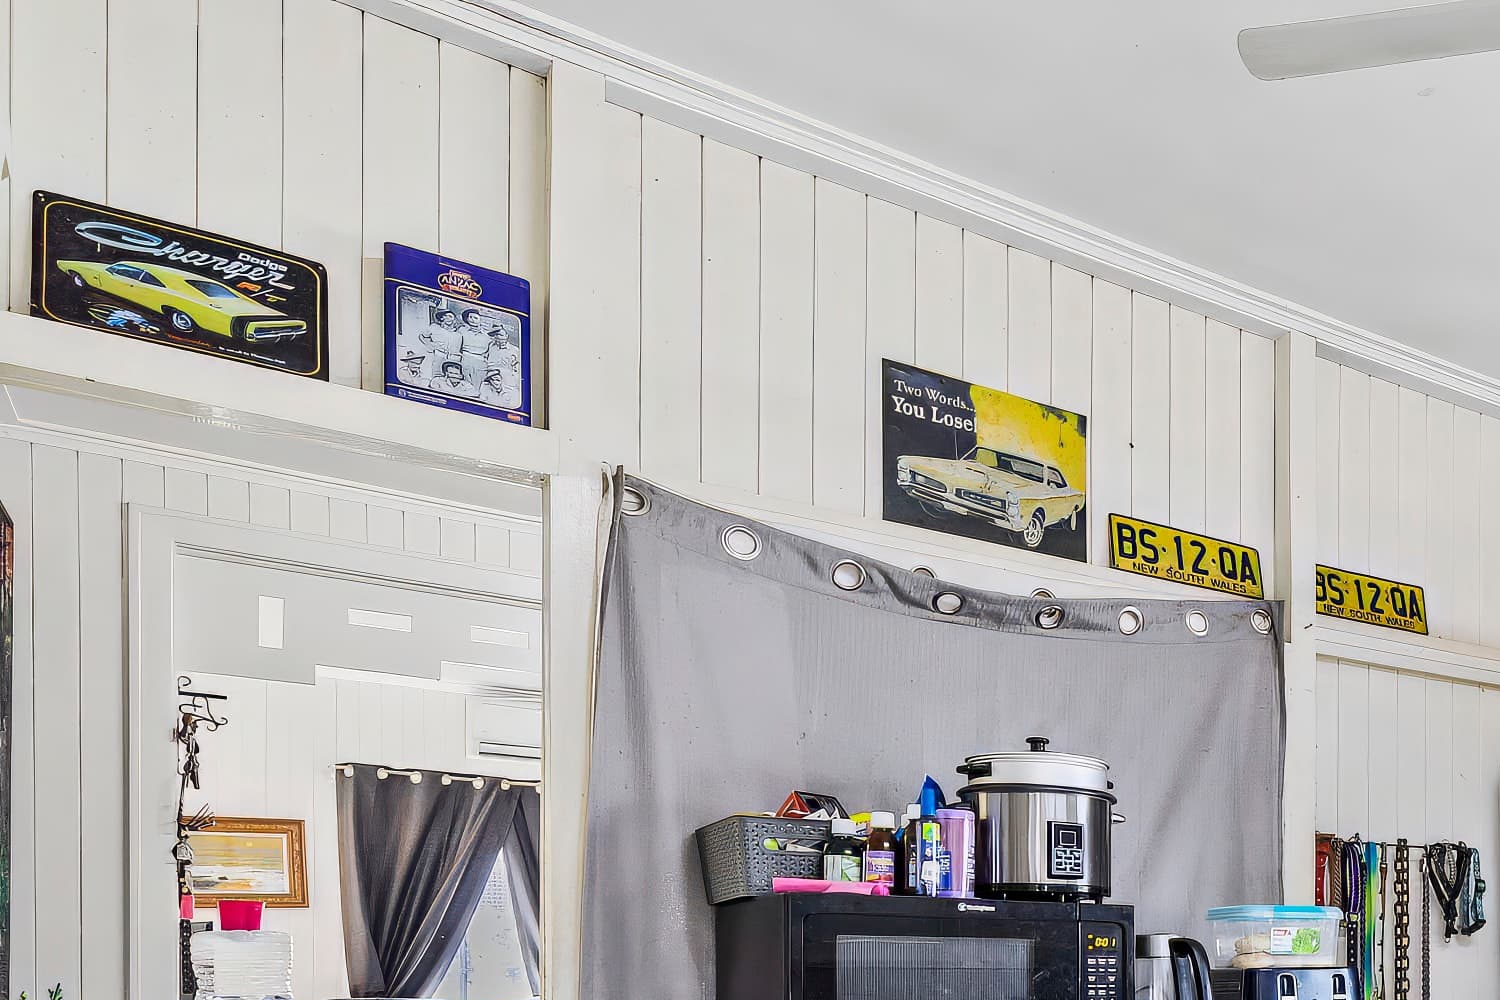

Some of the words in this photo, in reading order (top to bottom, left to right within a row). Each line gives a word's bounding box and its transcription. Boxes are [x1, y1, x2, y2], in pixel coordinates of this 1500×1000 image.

[74, 221, 296, 290] Charger
[237, 252, 289, 272] Dodge
[893, 379, 922, 397] Two
[891, 395, 926, 419] You
[1132, 562, 1159, 575] NEW
[1166, 567, 1205, 585] SOUTH
[1210, 578, 1247, 594] WALES
[1323, 603, 1345, 616] NEW
[1349, 608, 1382, 623] SOUTH
